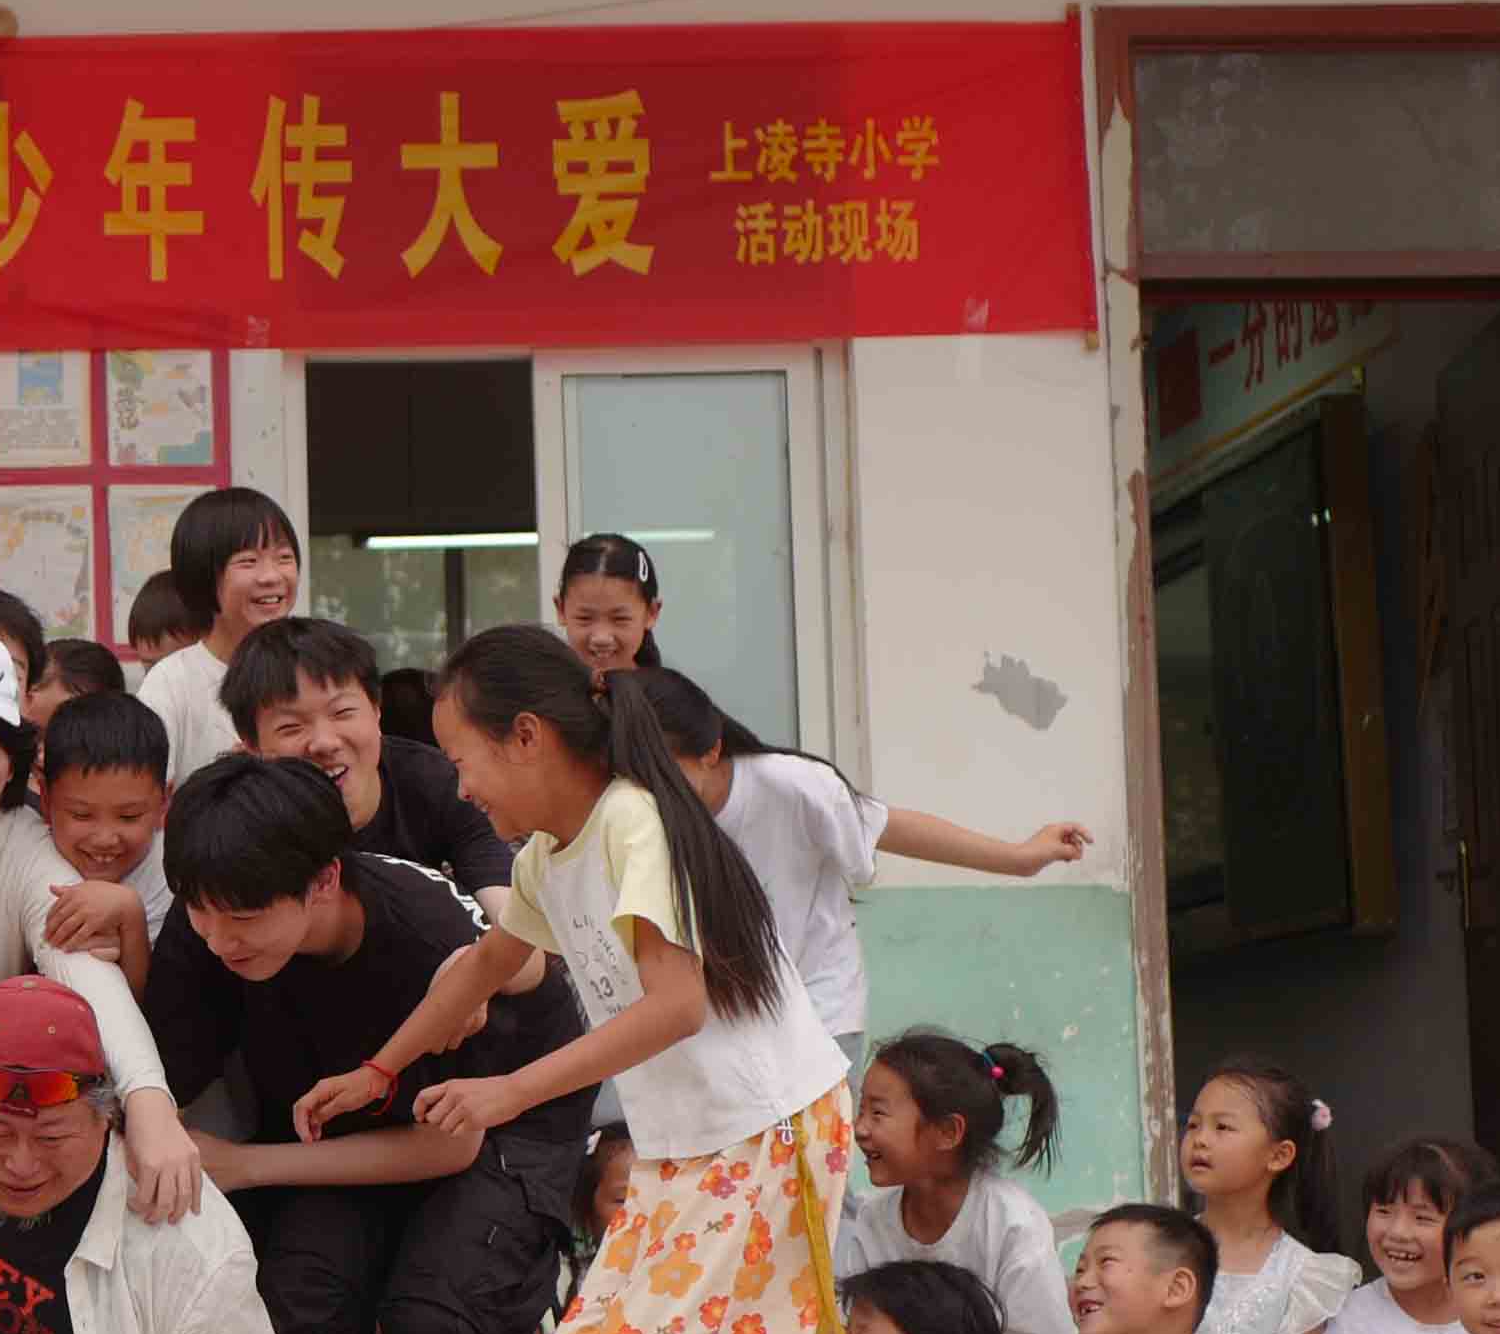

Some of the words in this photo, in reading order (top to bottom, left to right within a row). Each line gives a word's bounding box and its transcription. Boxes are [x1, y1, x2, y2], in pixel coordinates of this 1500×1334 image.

[709, 116, 939, 183] 上凌寺小学
[734, 200, 920, 265] 活动现场
